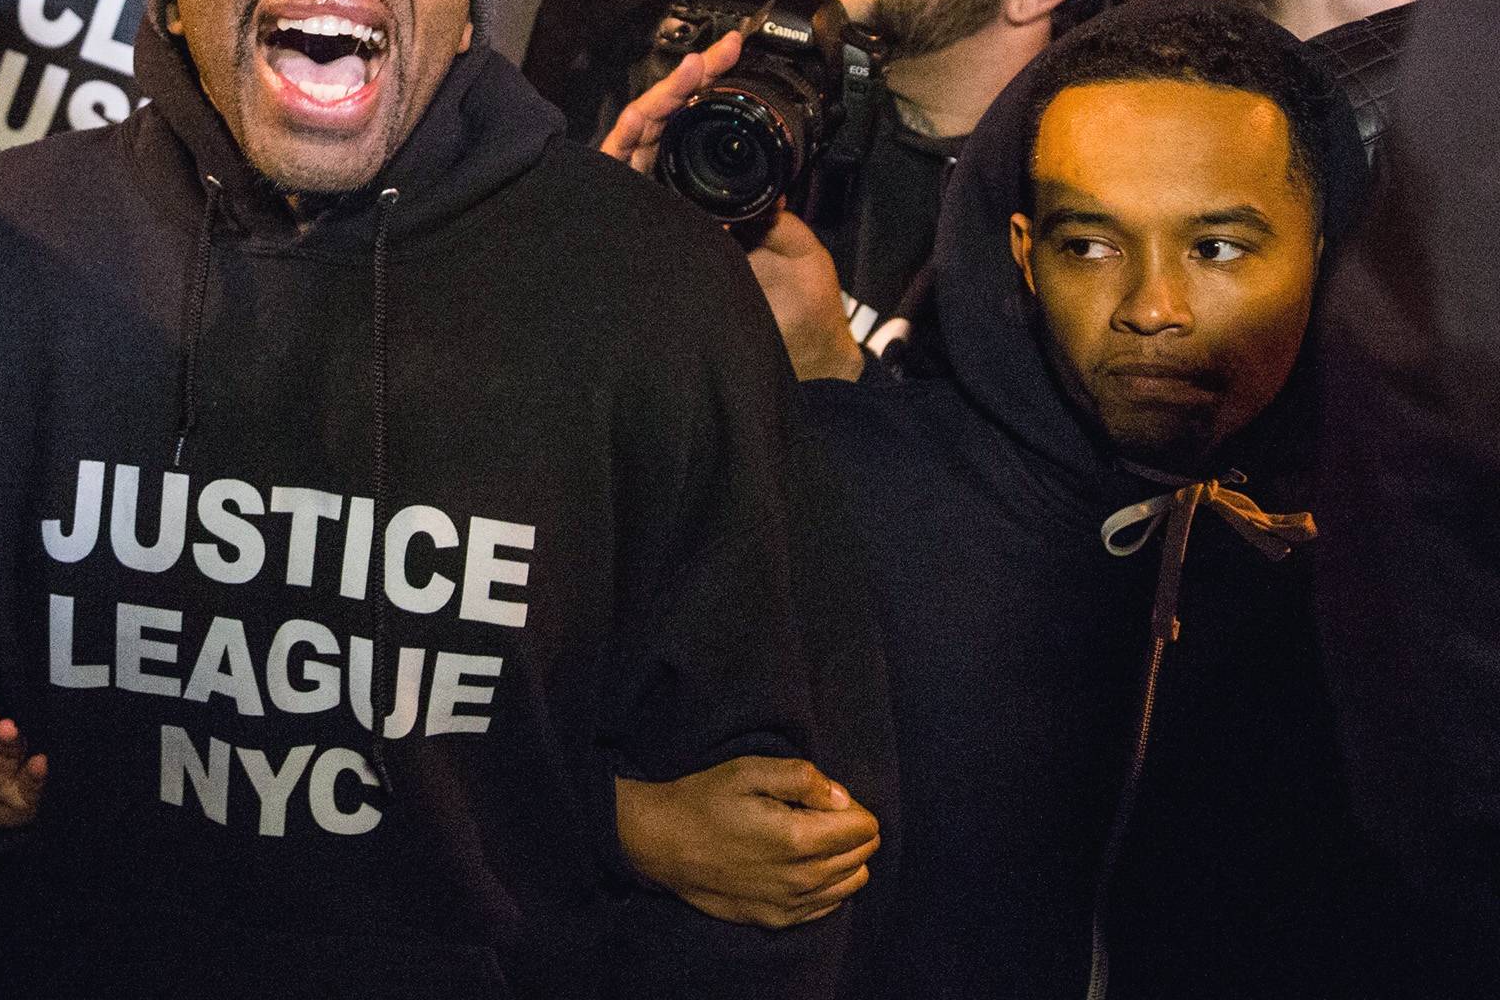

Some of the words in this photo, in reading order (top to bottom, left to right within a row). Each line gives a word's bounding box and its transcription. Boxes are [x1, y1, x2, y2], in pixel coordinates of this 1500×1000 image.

[762, 21, 809, 41] Canon
[849, 65, 870, 77] EOS
[41, 459, 536, 628] JUSTICE
[49, 593, 503, 740] LEAGUE
[160, 724, 383, 838] NYC
